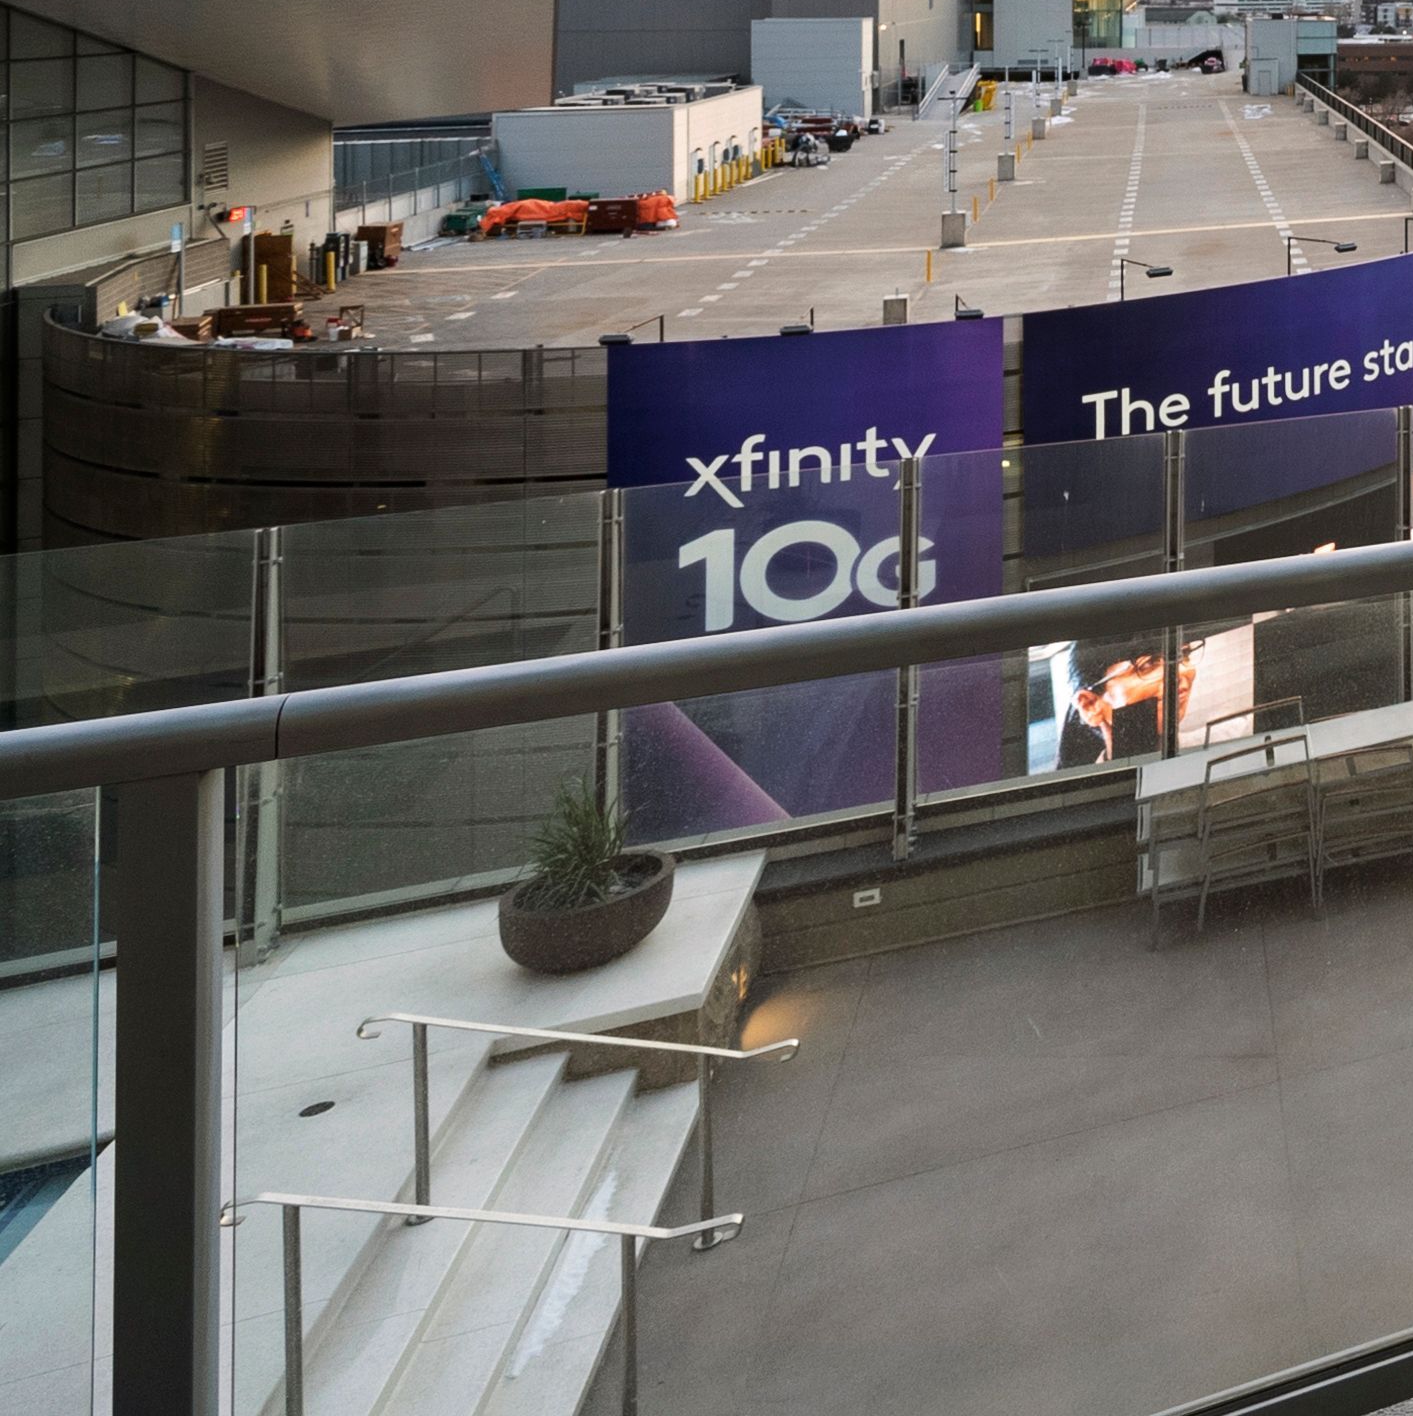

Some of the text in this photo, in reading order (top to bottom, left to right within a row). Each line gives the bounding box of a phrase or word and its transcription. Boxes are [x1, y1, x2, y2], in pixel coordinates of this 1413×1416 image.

[1081, 388, 1190, 441] The
[1207, 357, 1352, 418] future
[683, 426, 937, 509] xfinity
[678, 520, 937, 633] 10G
